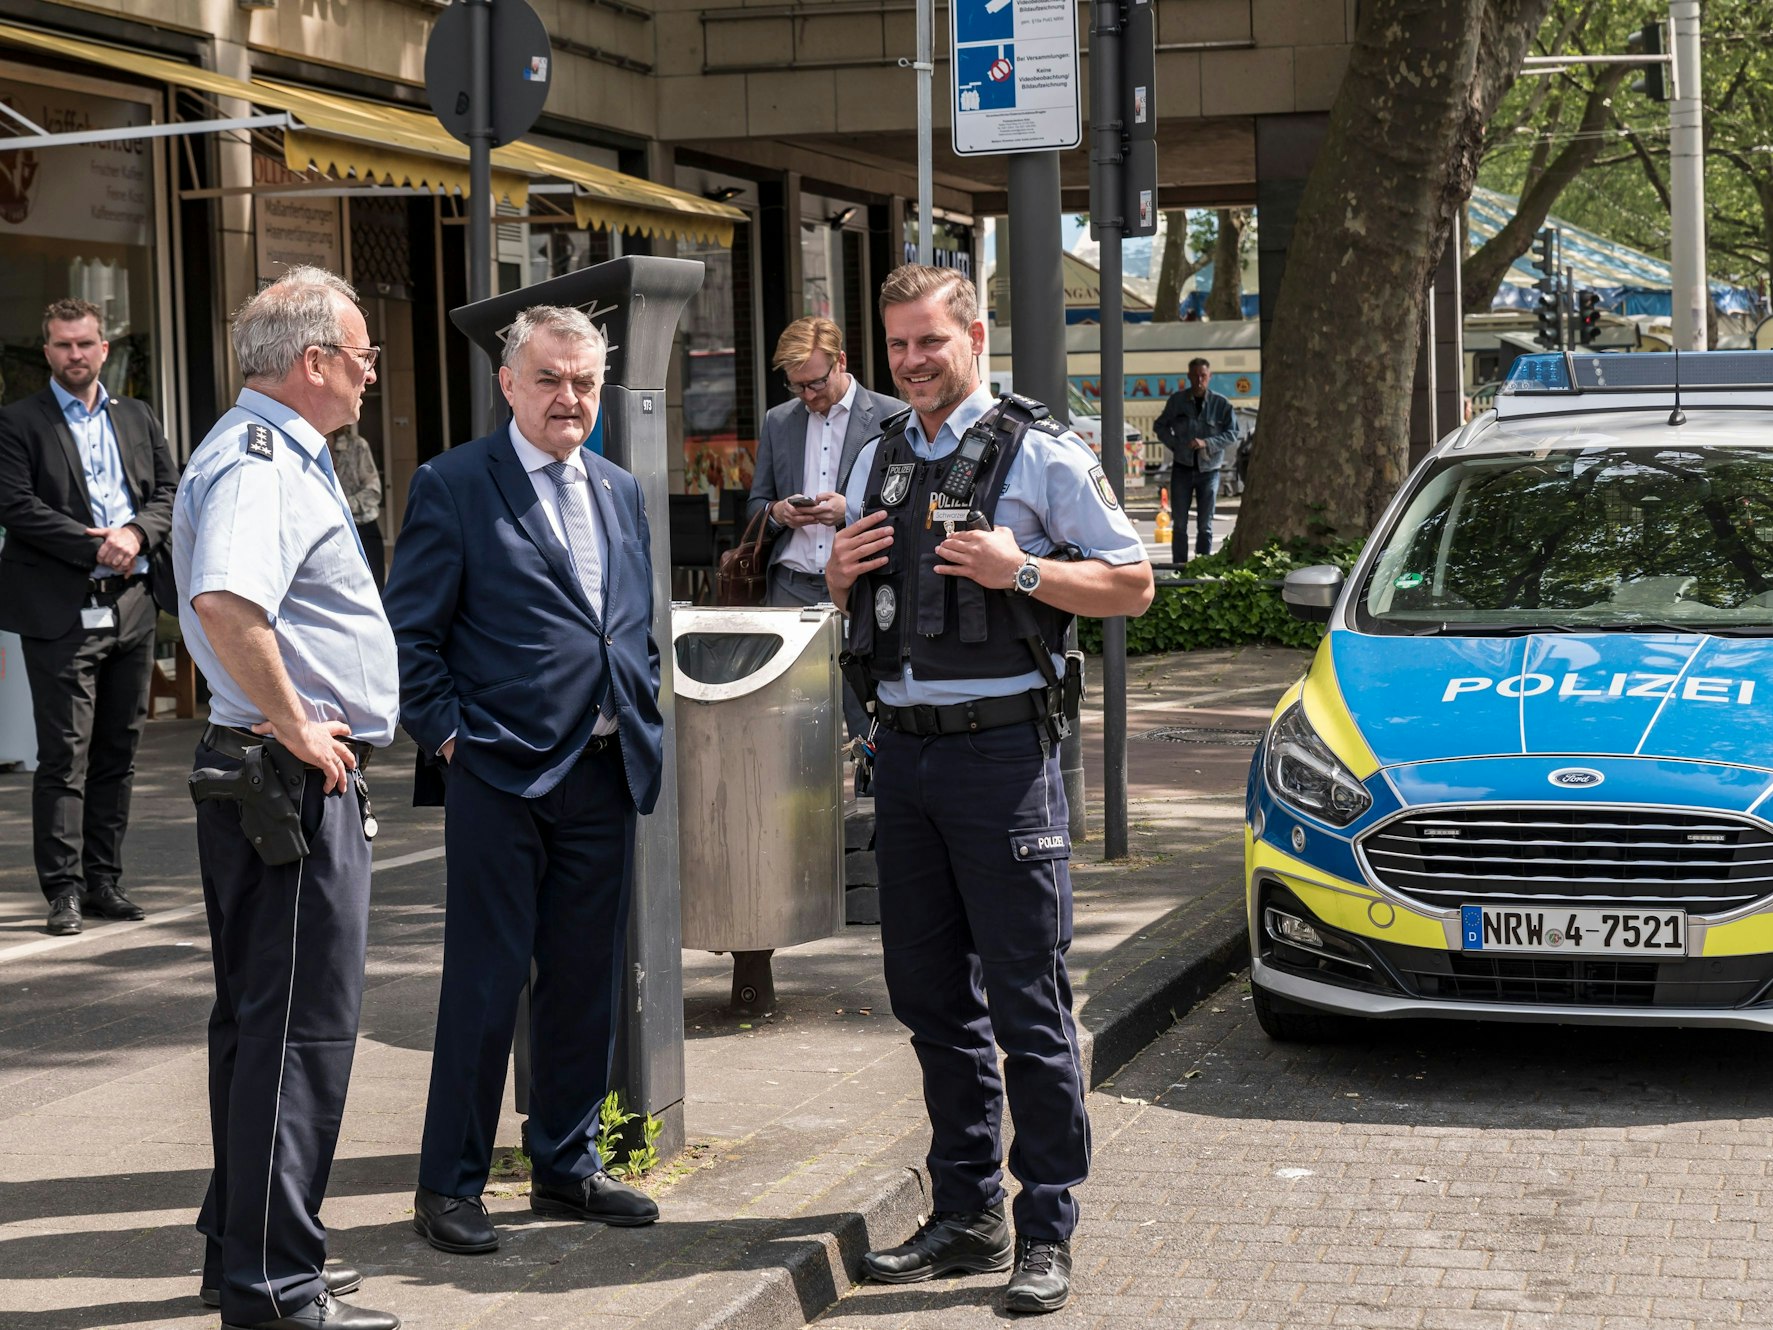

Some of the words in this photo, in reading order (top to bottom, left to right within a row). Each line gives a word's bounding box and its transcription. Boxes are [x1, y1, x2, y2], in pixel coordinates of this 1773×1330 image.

[1019, 4, 1065, 12] Bildaufzeichnung
[1027, 53, 1070, 61] Versammlungen:
[1019, 73, 1069, 82] Videobeobachtung/
[1021, 81, 1067, 90] Bildaufzeichnung
[643, 400, 652, 411] 973
[890, 466, 912, 474] POLIZEI
[936, 510, 966, 519] Schwarzer
[1442, 673, 1755, 704] POLIZEI
[1562, 773, 1590, 784] Ford
[1483, 912, 1544, 945] NRW
[1565, 914, 1683, 948] 4-7521
[1468, 931, 1477, 942] D
